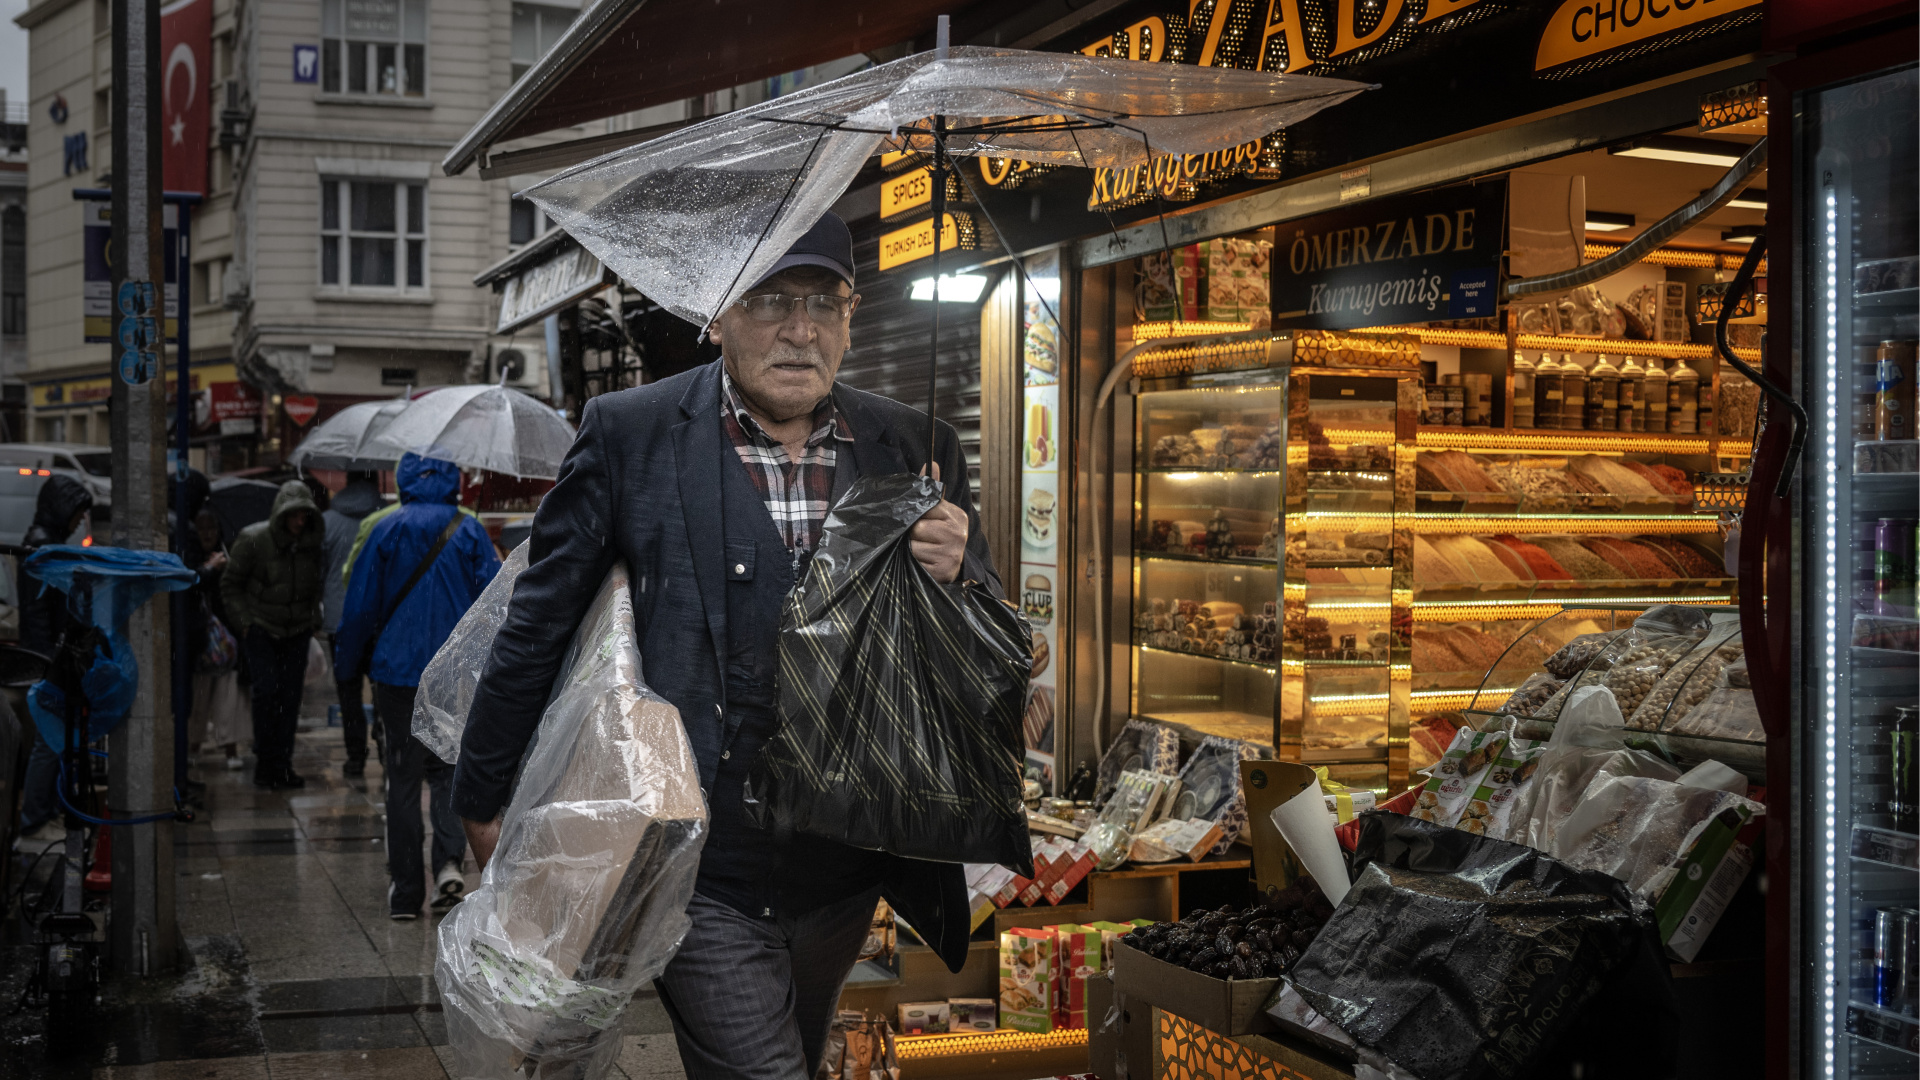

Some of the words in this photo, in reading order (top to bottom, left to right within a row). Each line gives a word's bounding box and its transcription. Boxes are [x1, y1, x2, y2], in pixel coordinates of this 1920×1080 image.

[1572, 0, 1716, 43] CHOC
[893, 175, 926, 205] SPICES
[885, 236, 916, 259] TURKISH
[918, 223, 951, 248] DELIHT
[1290, 209, 1476, 275] ÖMERZADE
[1308, 268, 1442, 316] Kuruyemiş
[1459, 280, 1487, 290] Accepted
[1025, 591, 1052, 609] CLUP
